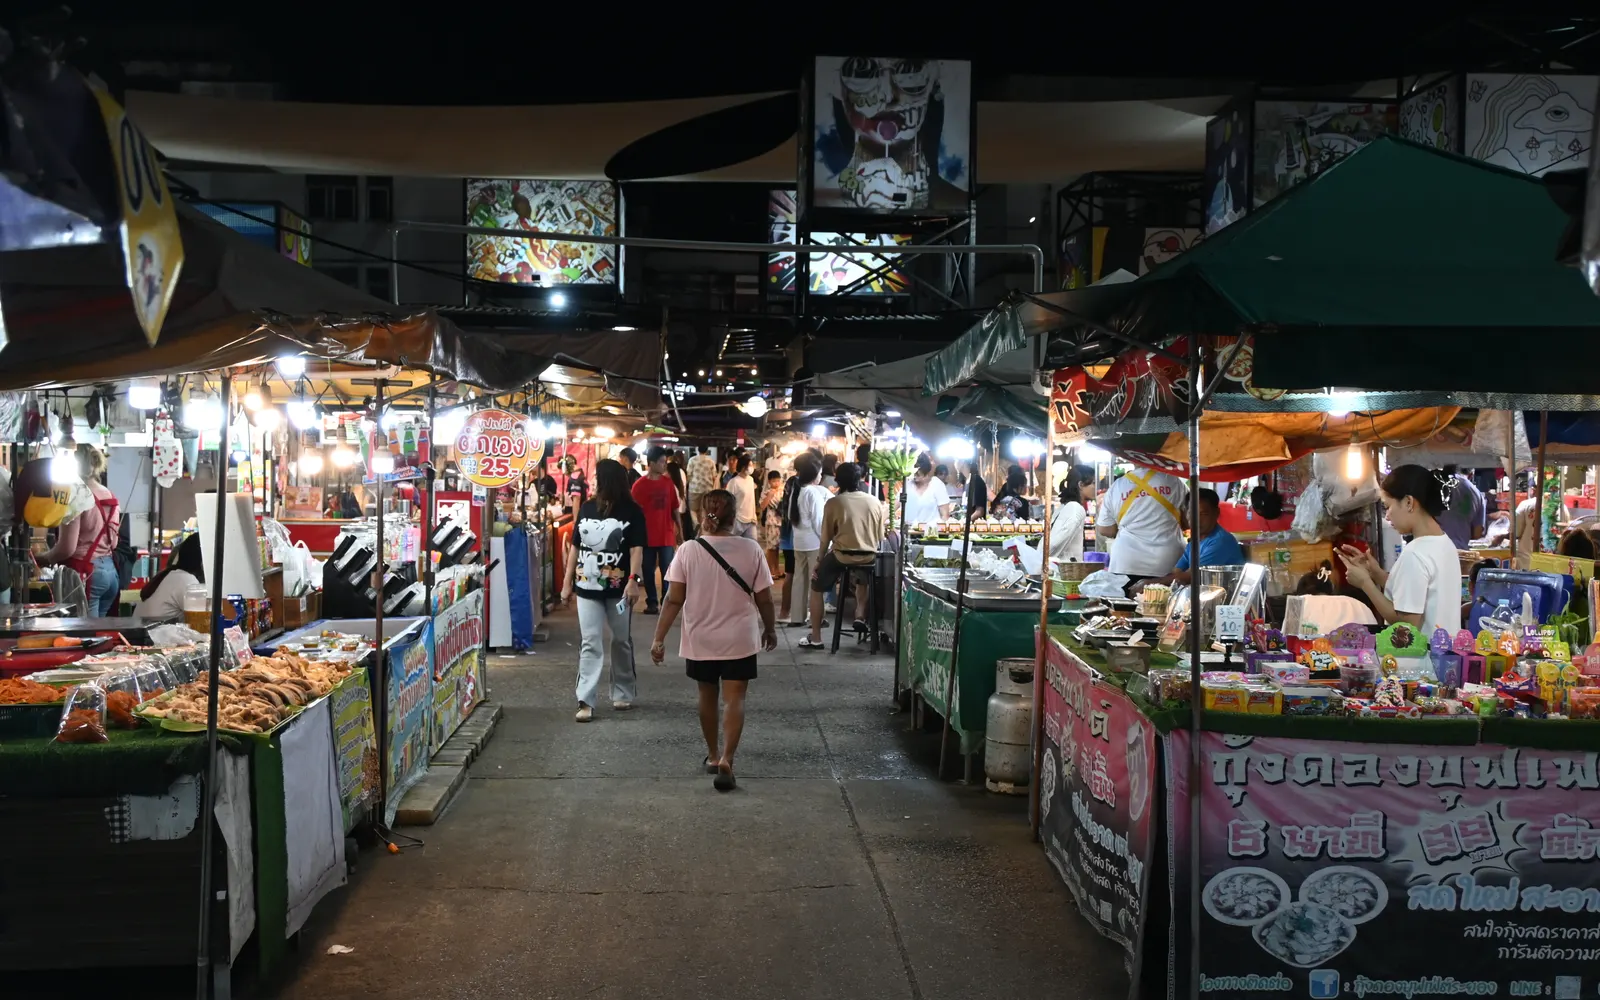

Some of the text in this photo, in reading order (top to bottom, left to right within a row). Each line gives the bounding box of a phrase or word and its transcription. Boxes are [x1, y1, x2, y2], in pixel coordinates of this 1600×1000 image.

[1419, 810, 1497, 863] 99
[1456, 874, 1520, 912] ใหม่
[1520, 884, 1600, 913] สะอา
[1509, 980, 1543, 996] LINE
